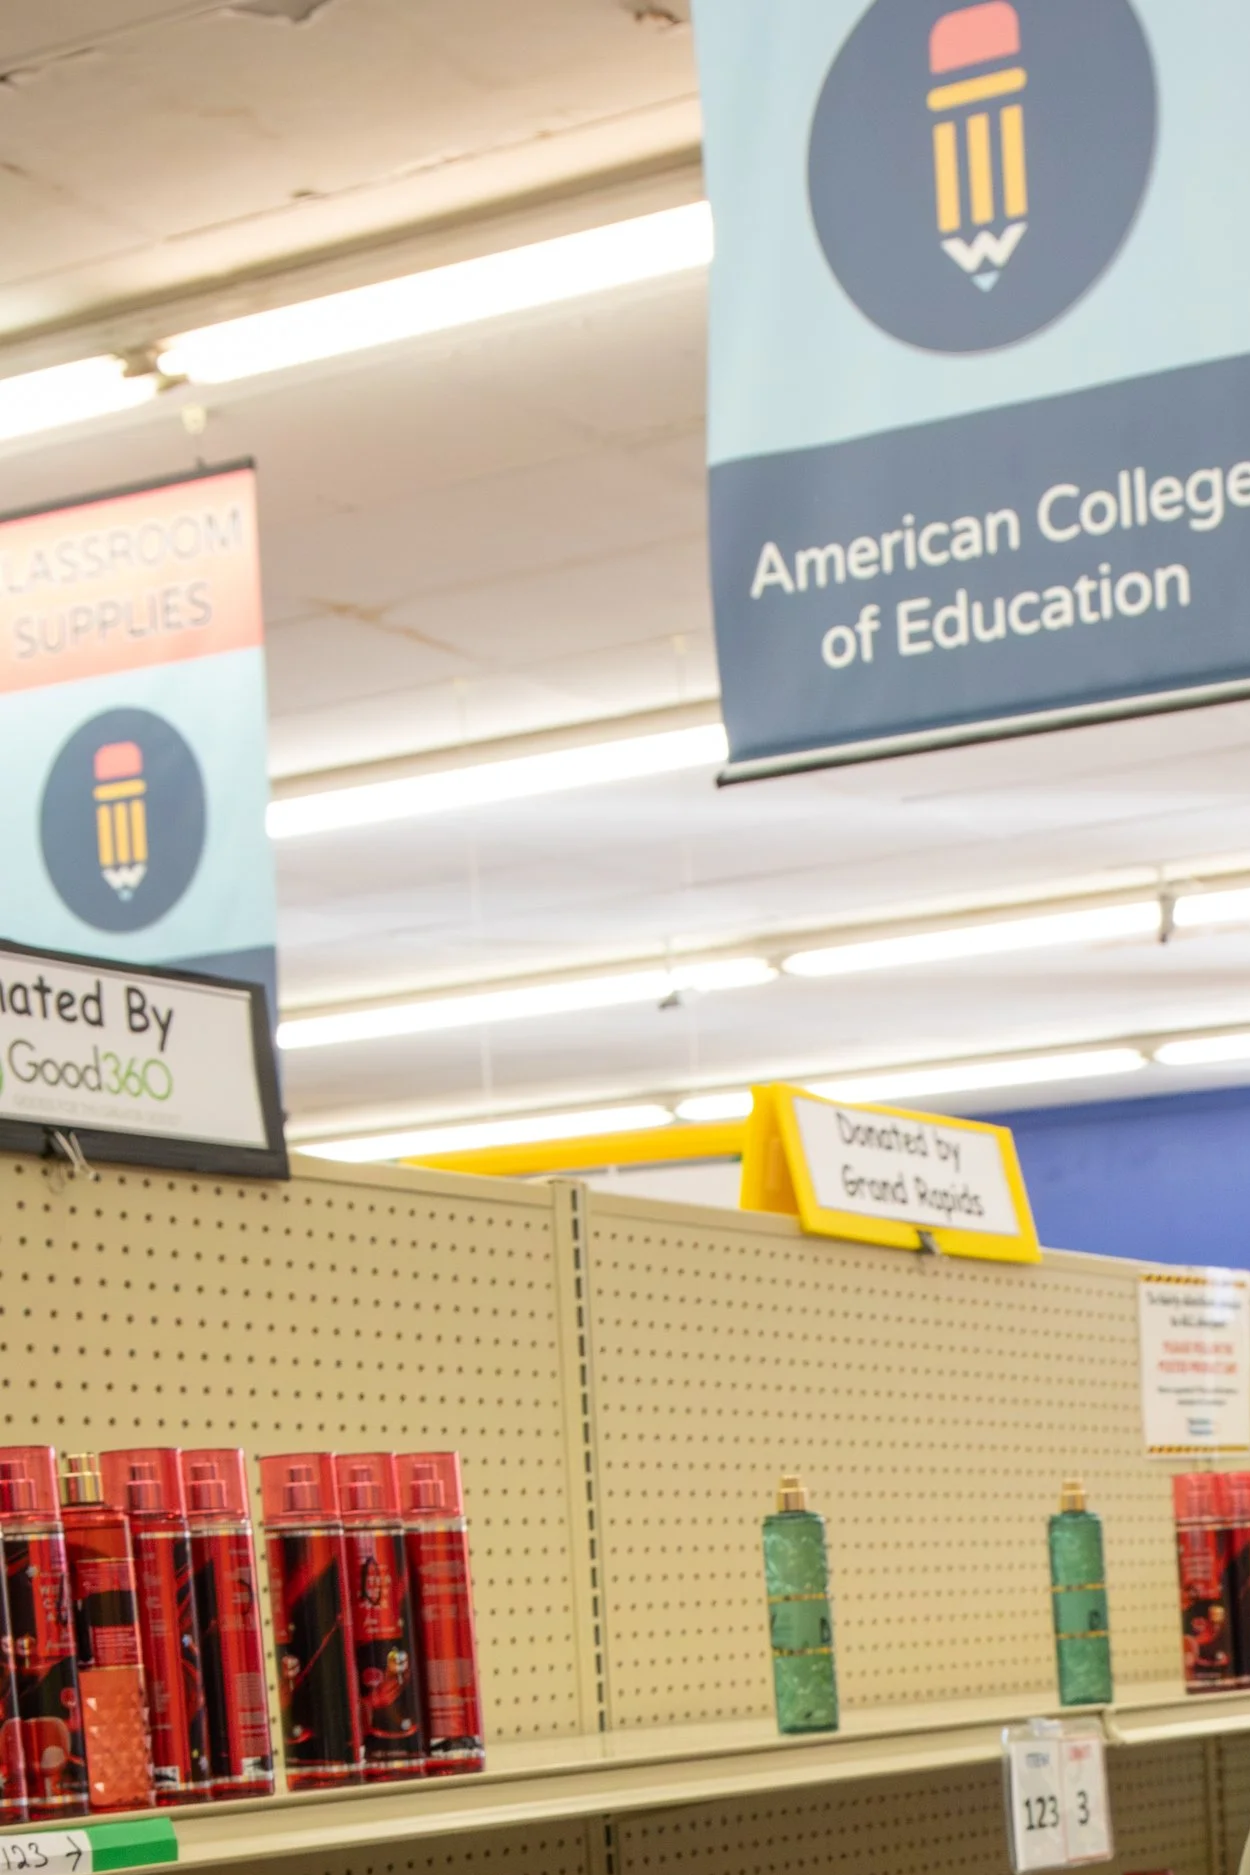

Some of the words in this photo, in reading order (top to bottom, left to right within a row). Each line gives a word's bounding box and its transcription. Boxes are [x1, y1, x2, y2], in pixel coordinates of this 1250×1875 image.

[751, 507, 1019, 599] American
[13, 581, 213, 659] SUPPLIES
[821, 605, 880, 668] of
[899, 564, 1191, 656] Education
[0, 974, 104, 1027] ated
[125, 986, 174, 1052] By
[8, 1039, 173, 1101] Good360
[835, 1111, 928, 1158] Donated
[933, 1127, 960, 1174] by
[841, 1163, 908, 1204] Grand
[914, 1176, 985, 1222] Rapids
[1024, 1795, 1060, 1830] 123
[1077, 1789, 1090, 1826] 3
[1, 1842, 49, 1870] 123
